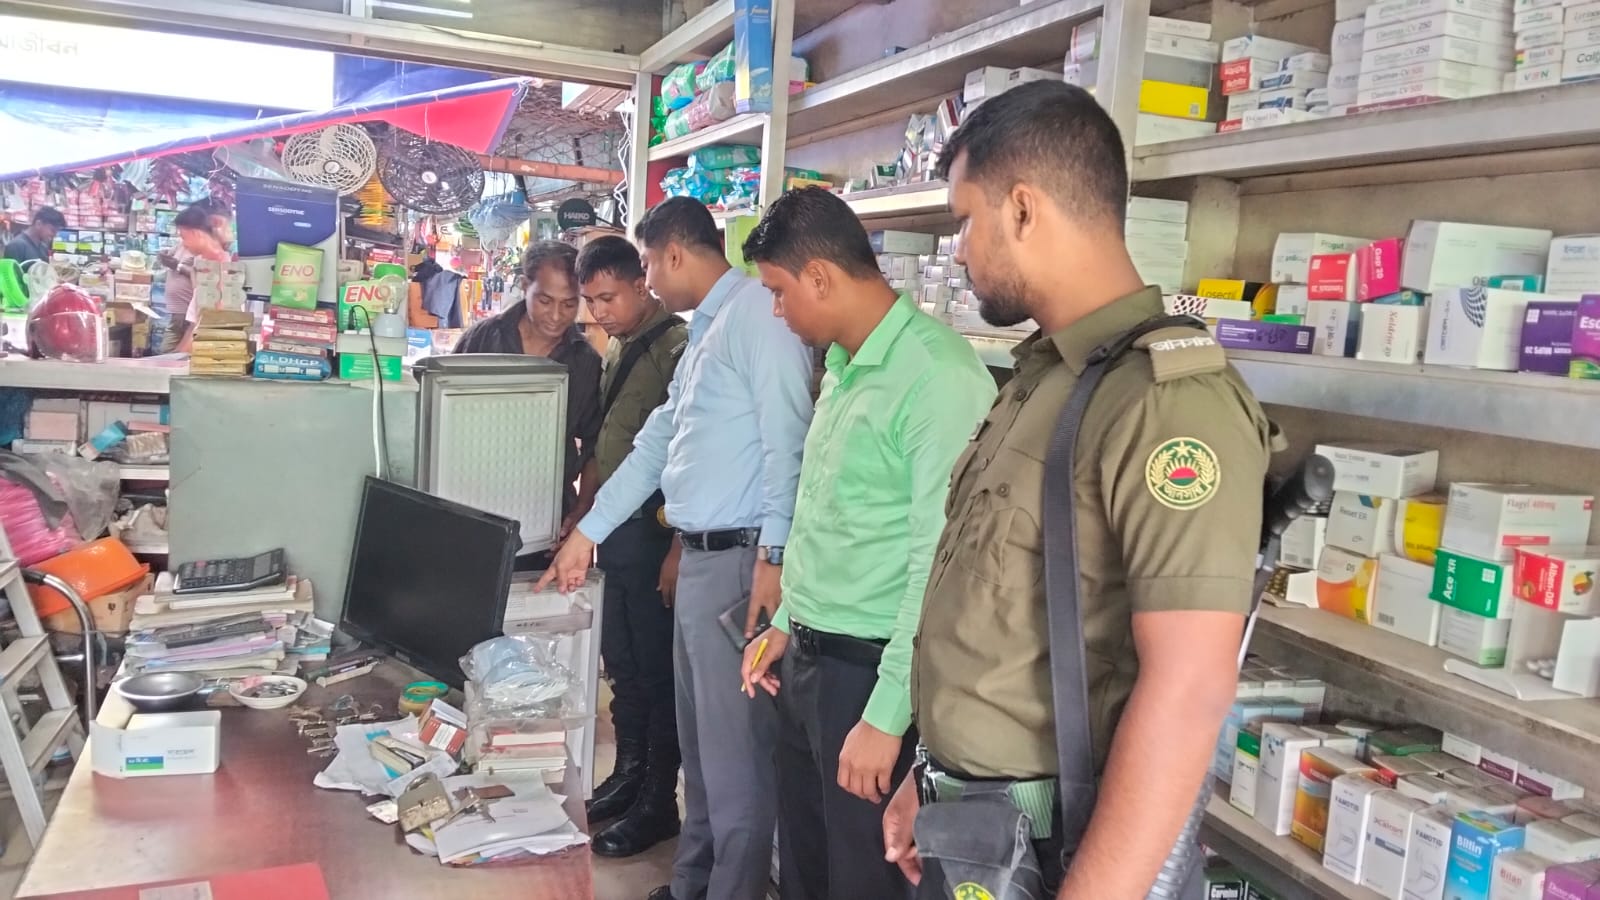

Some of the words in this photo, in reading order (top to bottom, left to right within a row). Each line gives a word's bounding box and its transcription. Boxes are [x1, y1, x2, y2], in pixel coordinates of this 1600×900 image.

[280, 264, 314, 277] ENO
[345, 285, 391, 303] ENO
[1506, 499, 1529, 511] Flagyl
[1448, 558, 1457, 574] XR
[1443, 575, 1454, 599] Ace
[1545, 562, 1559, 605] Alben-DS
